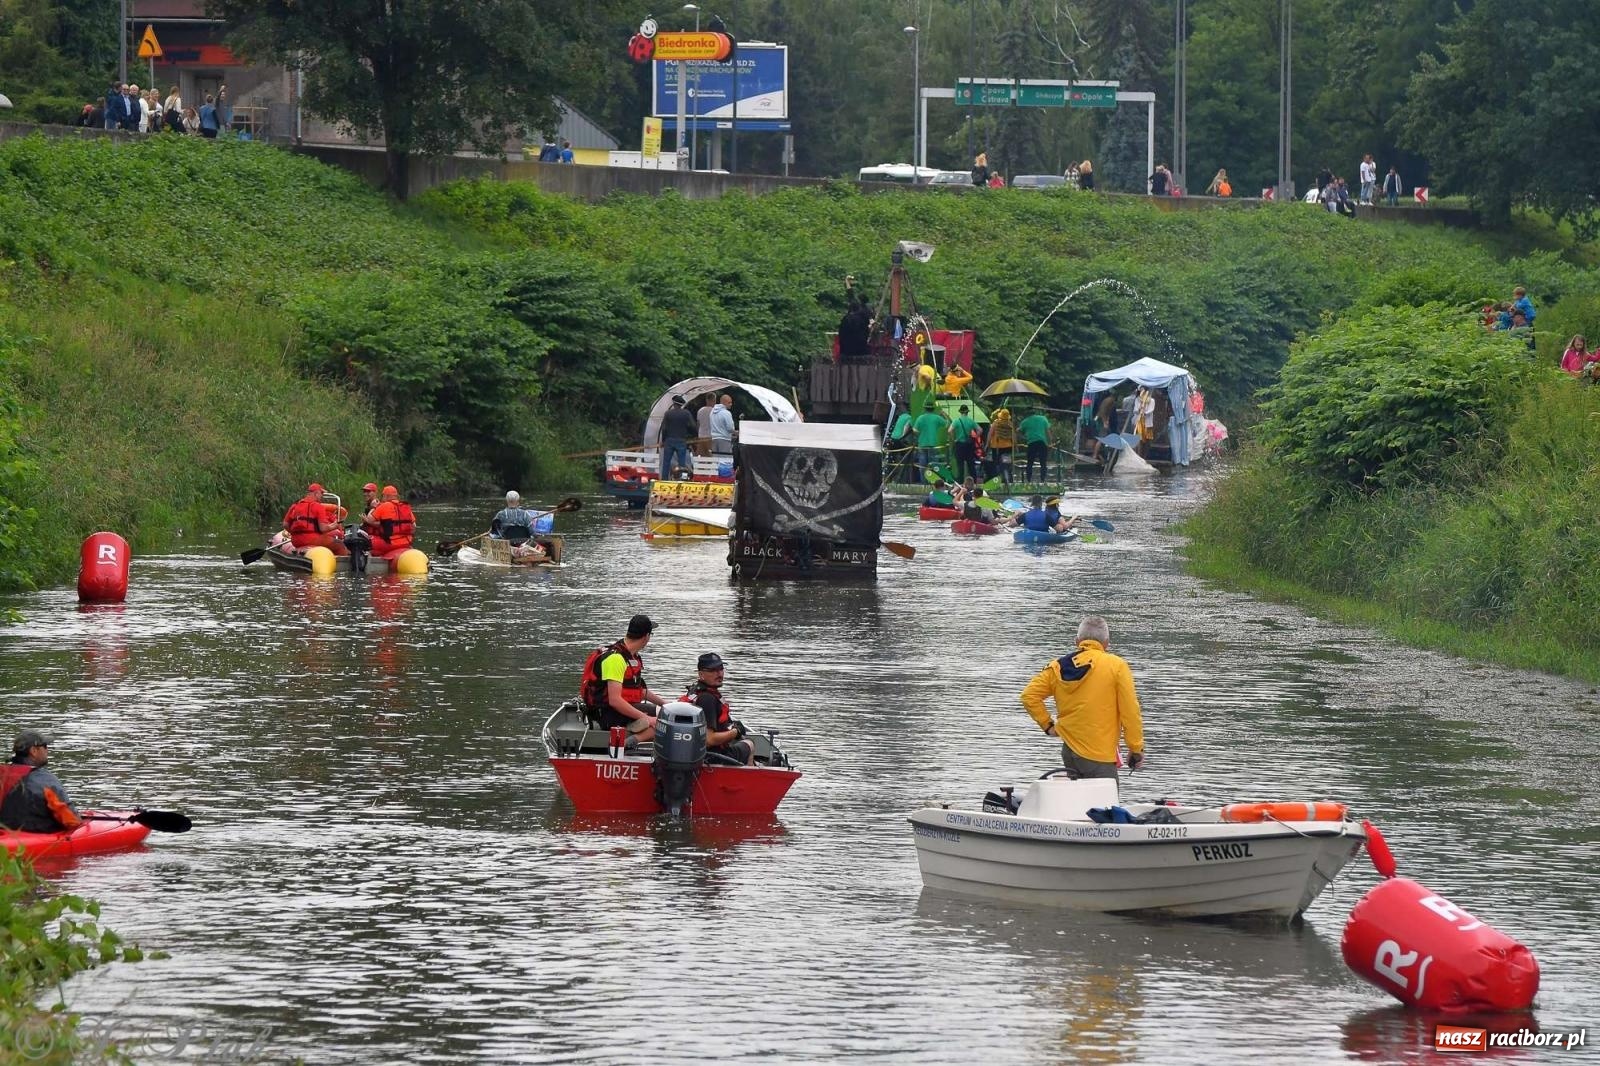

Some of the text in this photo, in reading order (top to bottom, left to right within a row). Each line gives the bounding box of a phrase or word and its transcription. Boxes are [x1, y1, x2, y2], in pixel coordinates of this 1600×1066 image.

[658, 37, 716, 48] Biedronka
[1082, 92, 1103, 102] Opole
[98, 543, 117, 561] R
[743, 546, 783, 558] BLACK
[832, 551, 869, 561] MARY
[673, 732, 693, 742] 30
[595, 763, 640, 780] TURZE
[1191, 842, 1253, 861] PERKOZ
